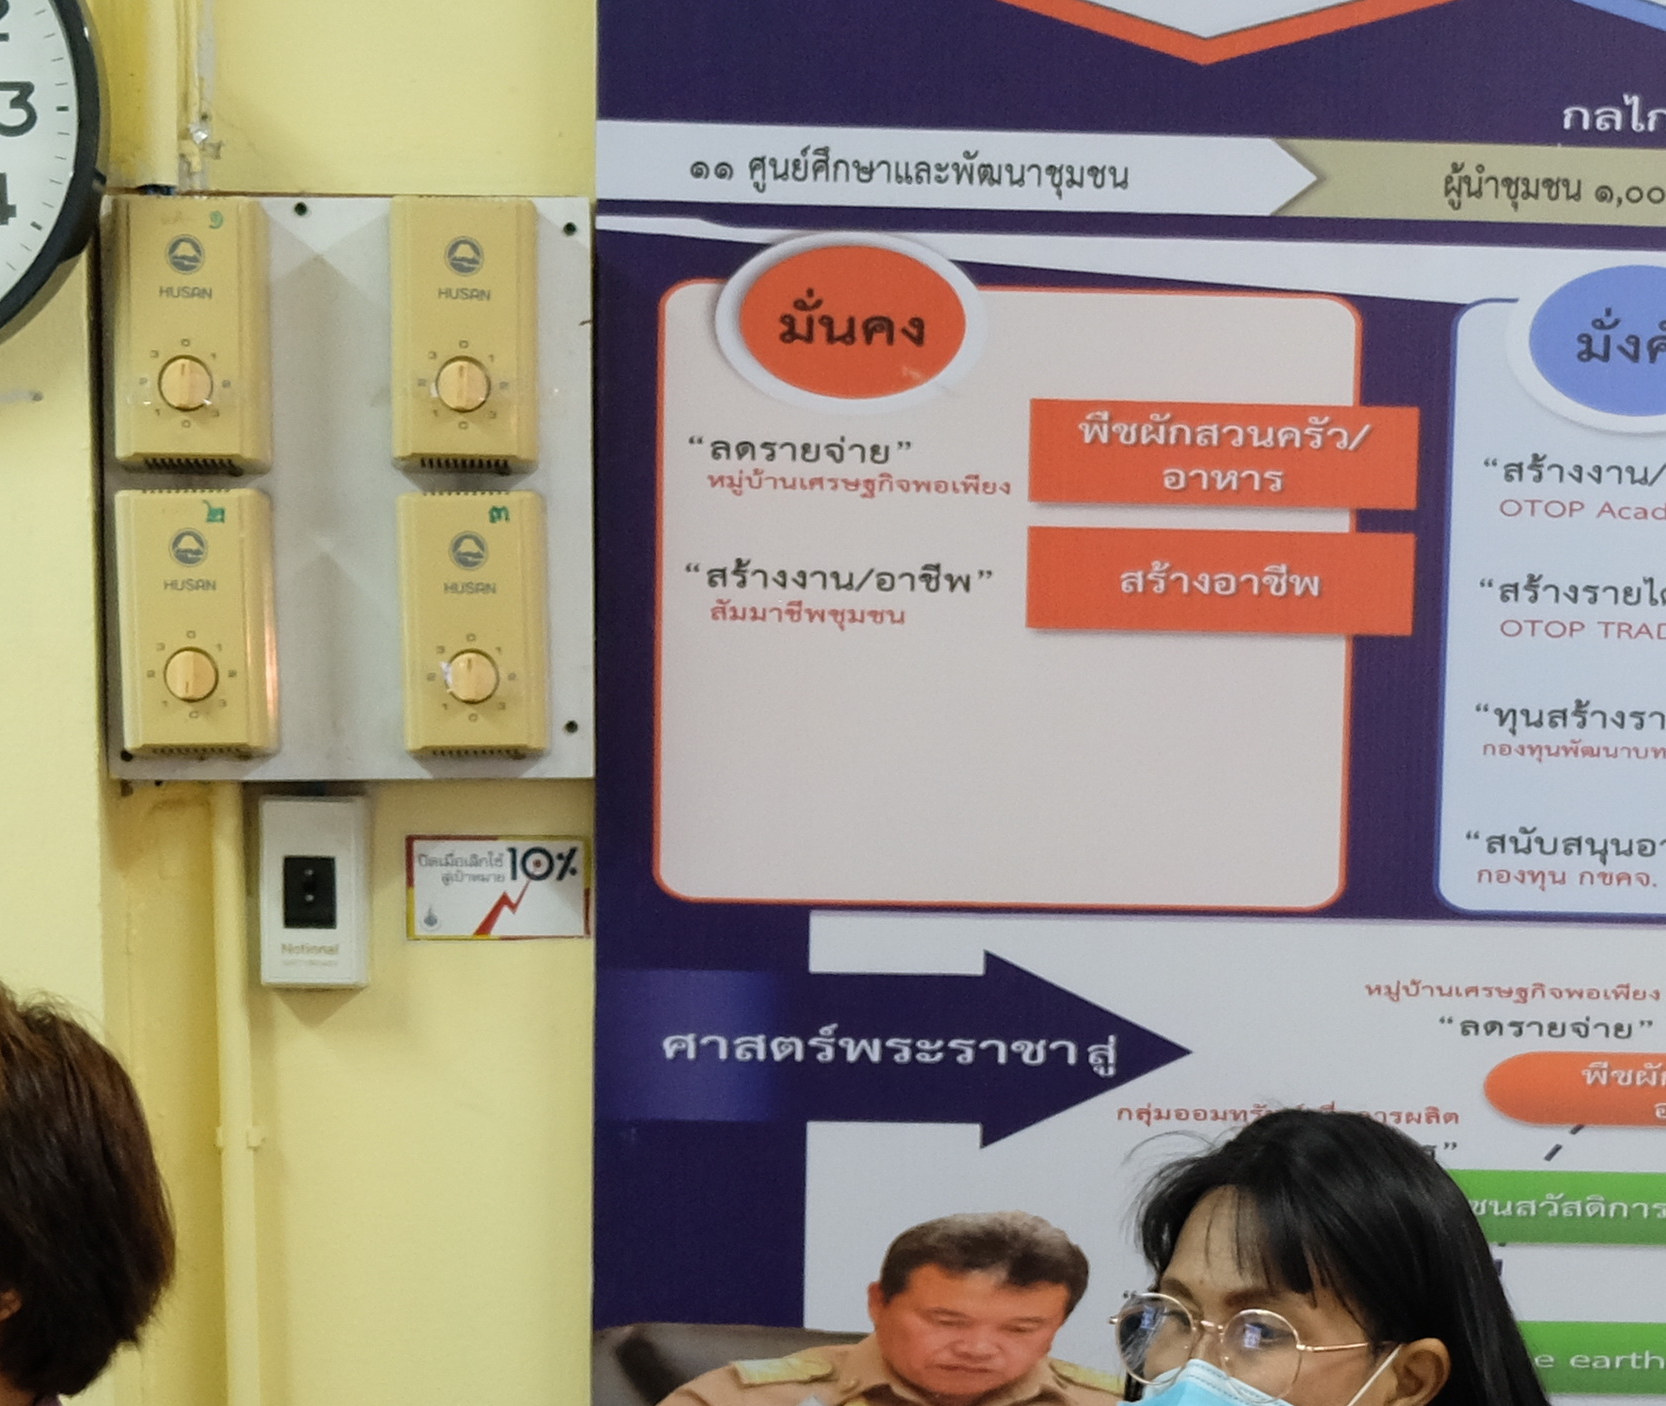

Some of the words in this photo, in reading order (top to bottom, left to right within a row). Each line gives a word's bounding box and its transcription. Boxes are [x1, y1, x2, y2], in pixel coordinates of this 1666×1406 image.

[690, 161, 733, 180] ๑๑
[749, 145, 1128, 200] ศูนย์ศึกษาและพัฒนาชุมชน
[1444, 162, 1581, 212] ผู้นำชุมชน
[158, 285, 214, 301] HUSAN
[437, 286, 493, 302] HUSAN
[780, 288, 925, 347] มั่นคง
[1079, 411, 1370, 450] พืชผักสวนครัว/
[707, 468, 1010, 499] หมู่บ้านเศรษฐกิจพอเพียง
[1164, 469, 1283, 491] อาหาร
[1500, 499, 1584, 518] OTOP
[163, 577, 218, 593] HUSAN
[443, 581, 498, 596] HUSAN
[1121, 561, 1319, 596] สร้างอาชีพ
[711, 599, 905, 631] สัมมาชีพชุมชน
[1500, 620, 1585, 638] OTOP
[507, 846, 580, 882] 10%
[1478, 869, 1566, 891] กองทุน
[1365, 979, 1660, 1004] หมู่บ้านเศรษฐกิจพอเพียง
[662, 1024, 1077, 1065] ศาสตร์พระราชา
[1087, 1035, 1116, 1077] สู่
[1570, 1350, 1666, 1372] earth
